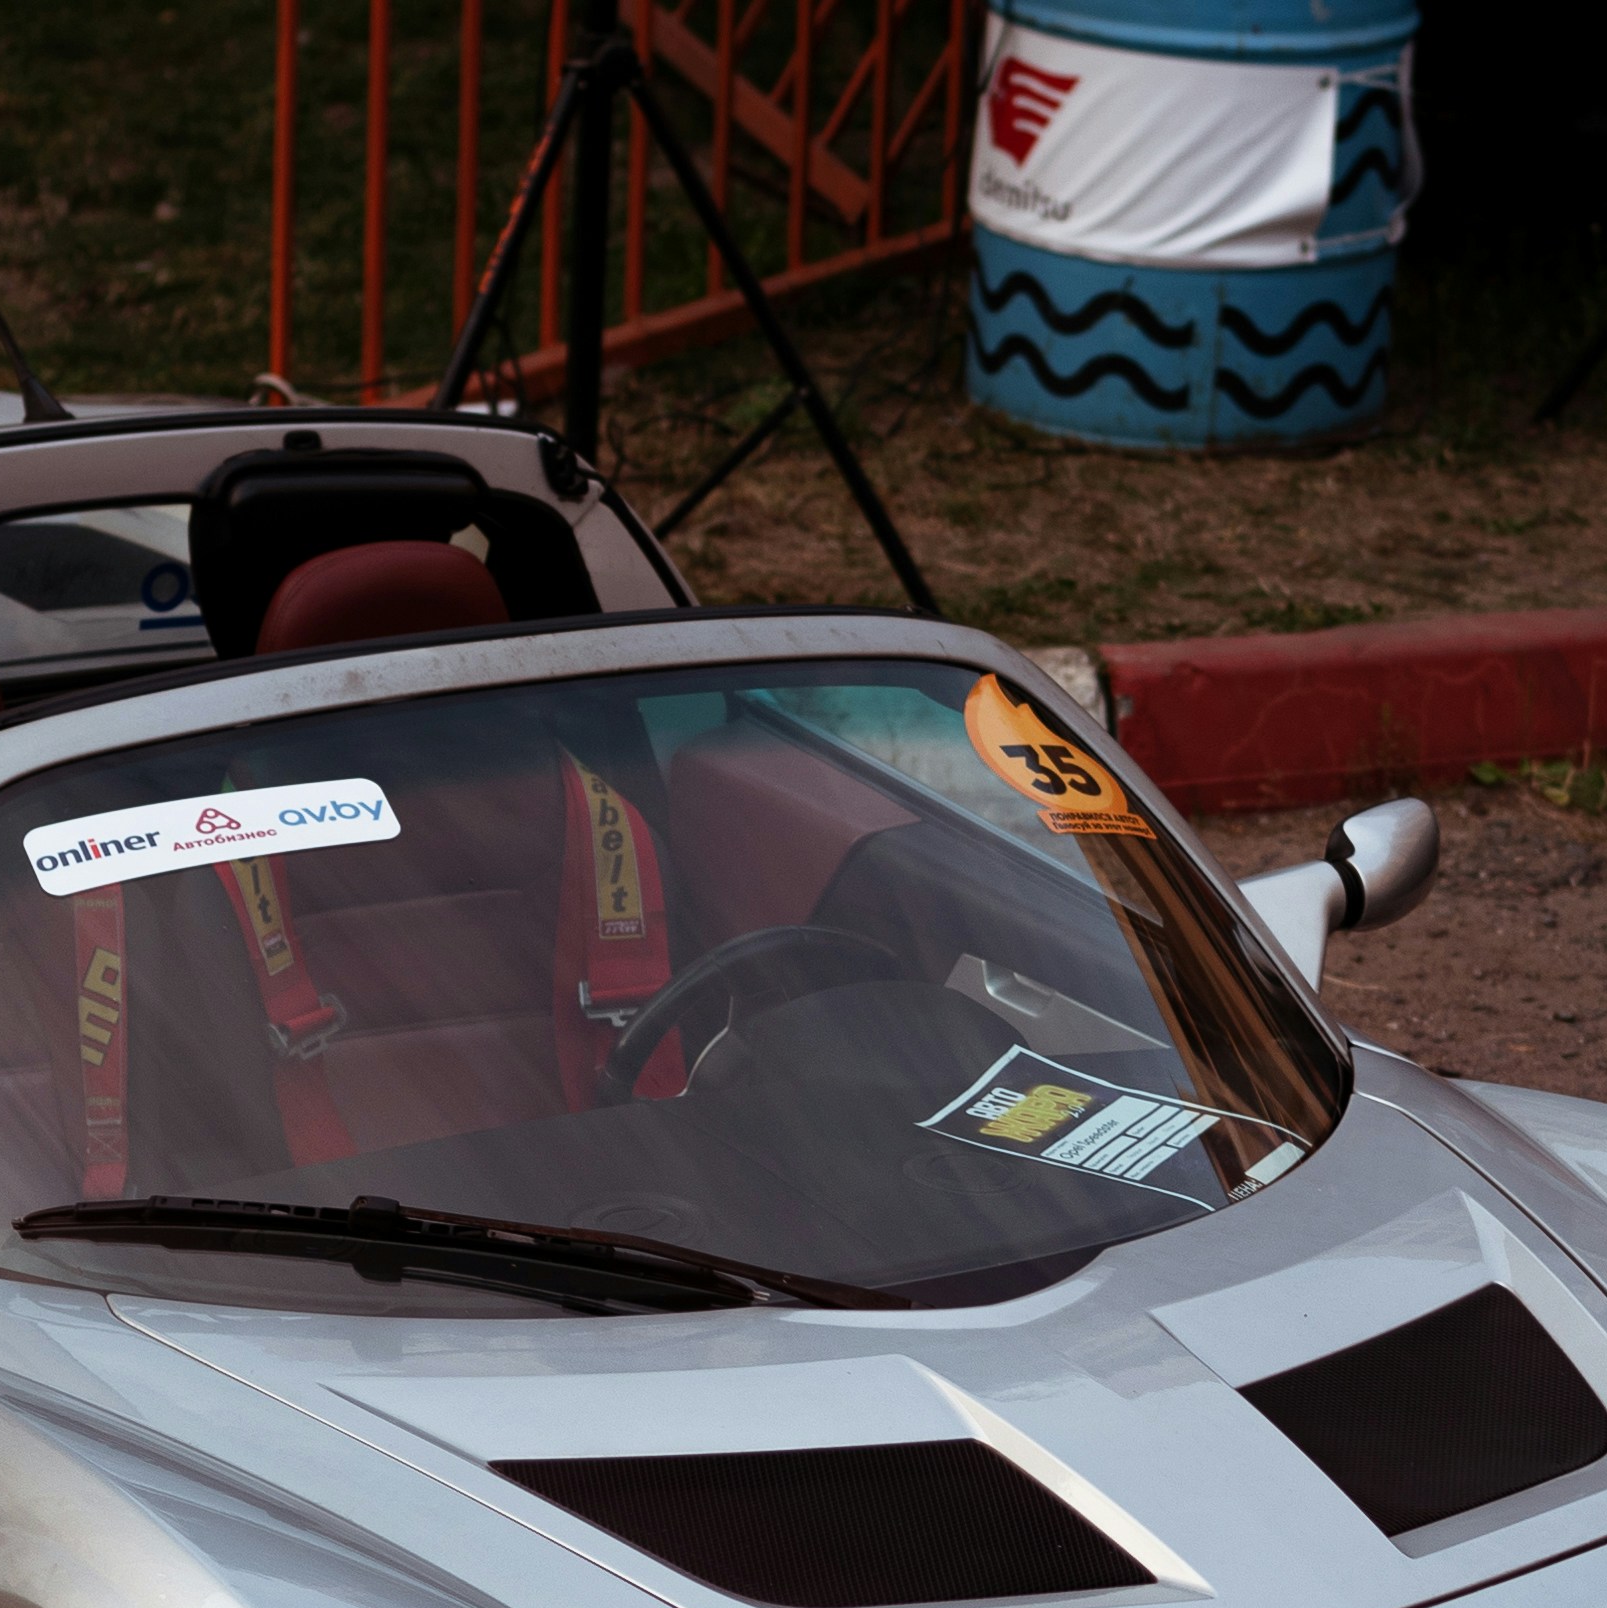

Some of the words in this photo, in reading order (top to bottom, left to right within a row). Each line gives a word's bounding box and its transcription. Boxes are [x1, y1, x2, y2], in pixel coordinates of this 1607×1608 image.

[998, 744, 1102, 796] 35
[278, 799, 383, 827] av.by
[1049, 811, 1114, 824] ПОНРАВИЛСЯ
[36, 830, 161, 872] onliner
[172, 828, 278, 852] Автобизнес
[966, 1087, 1027, 1120] АВТО
